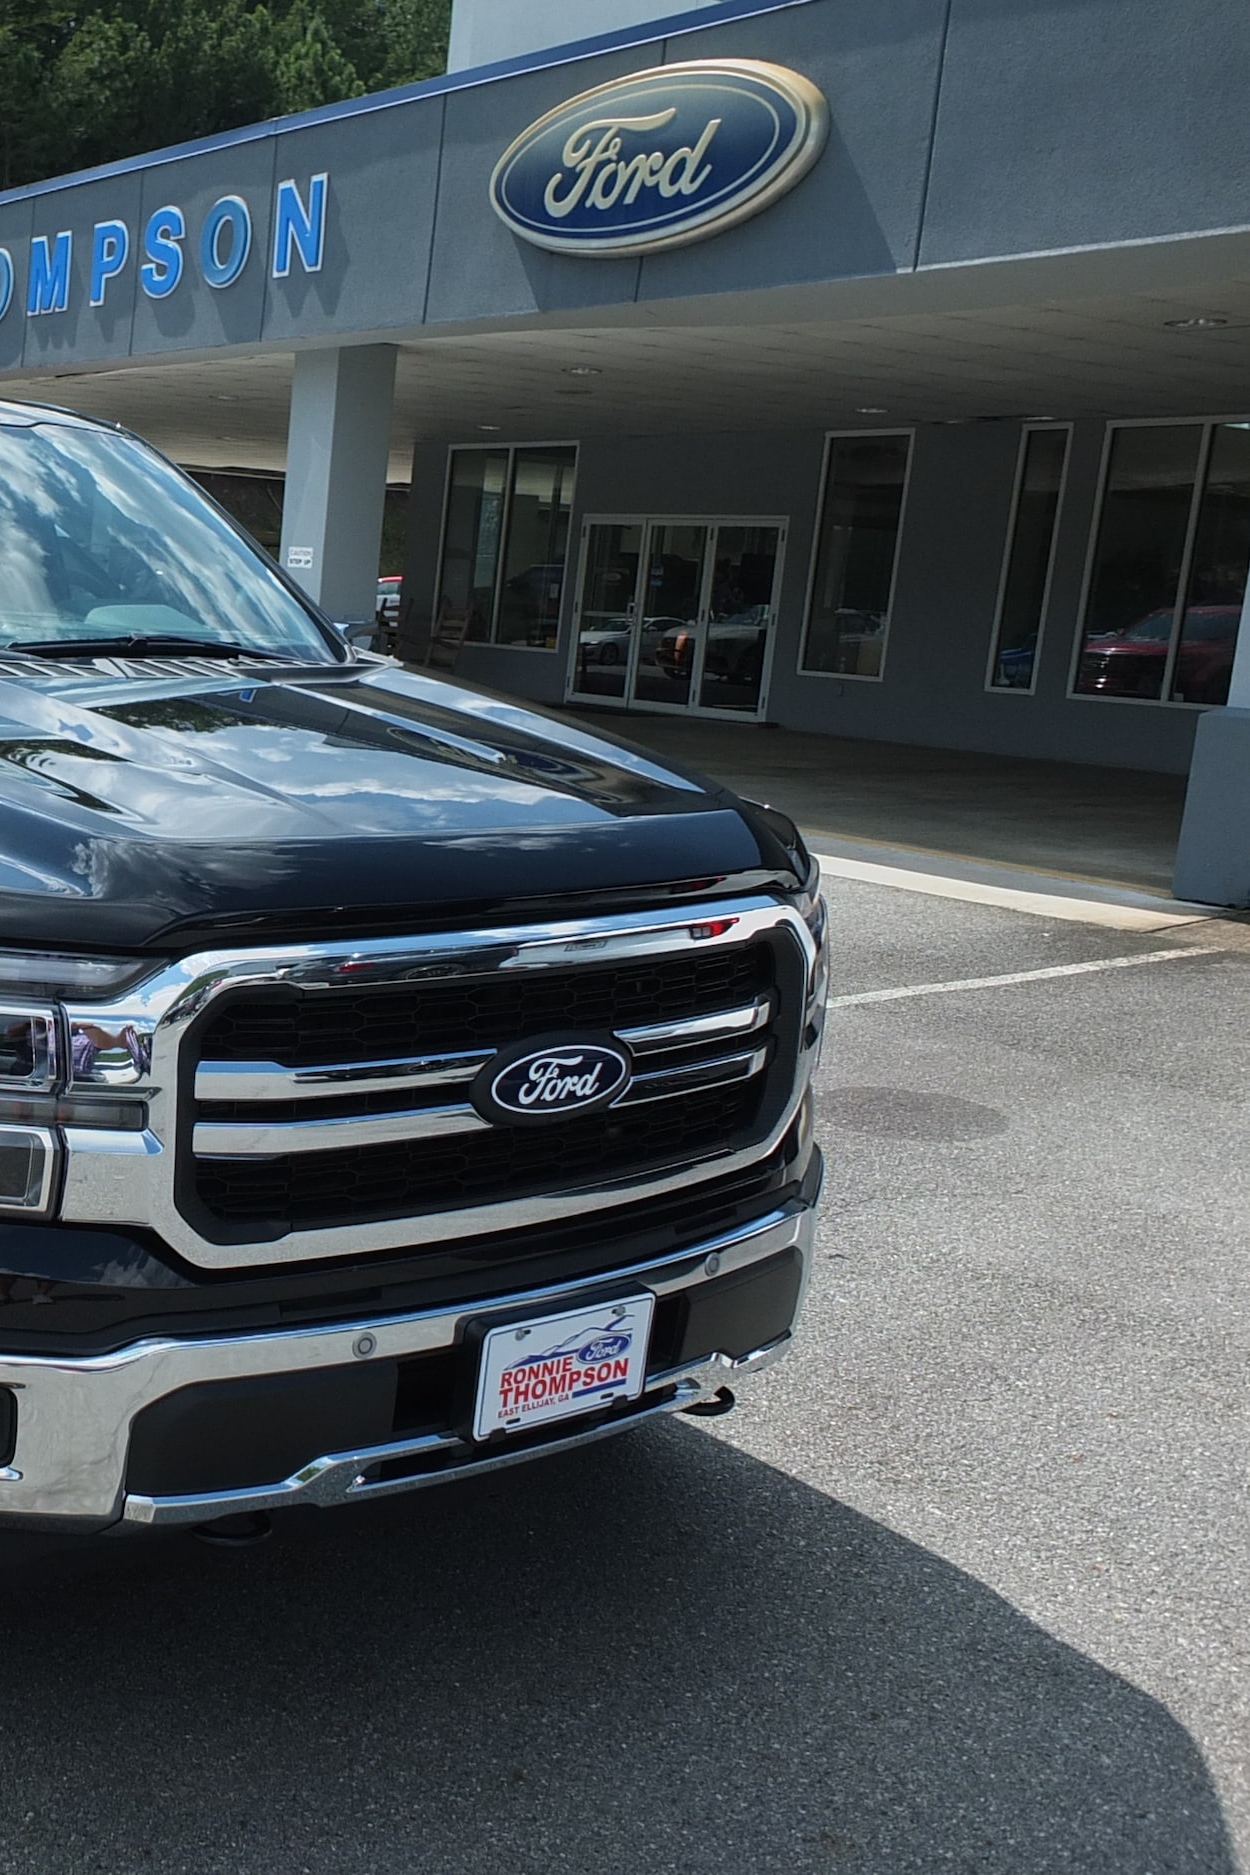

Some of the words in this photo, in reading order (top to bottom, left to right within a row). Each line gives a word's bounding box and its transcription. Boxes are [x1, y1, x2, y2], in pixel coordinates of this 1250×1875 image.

[544, 107, 722, 218] Ford
[518, 1055, 603, 1105] Ford
[585, 1337, 621, 1360] Ford
[498, 1358, 630, 1409] THOMPSON
[501, 1356, 574, 1388] RONNIE
[497, 1405, 520, 1419] EAST
[521, 1396, 557, 1412] ELLIJAY,
[557, 1394, 570, 1404] GA
